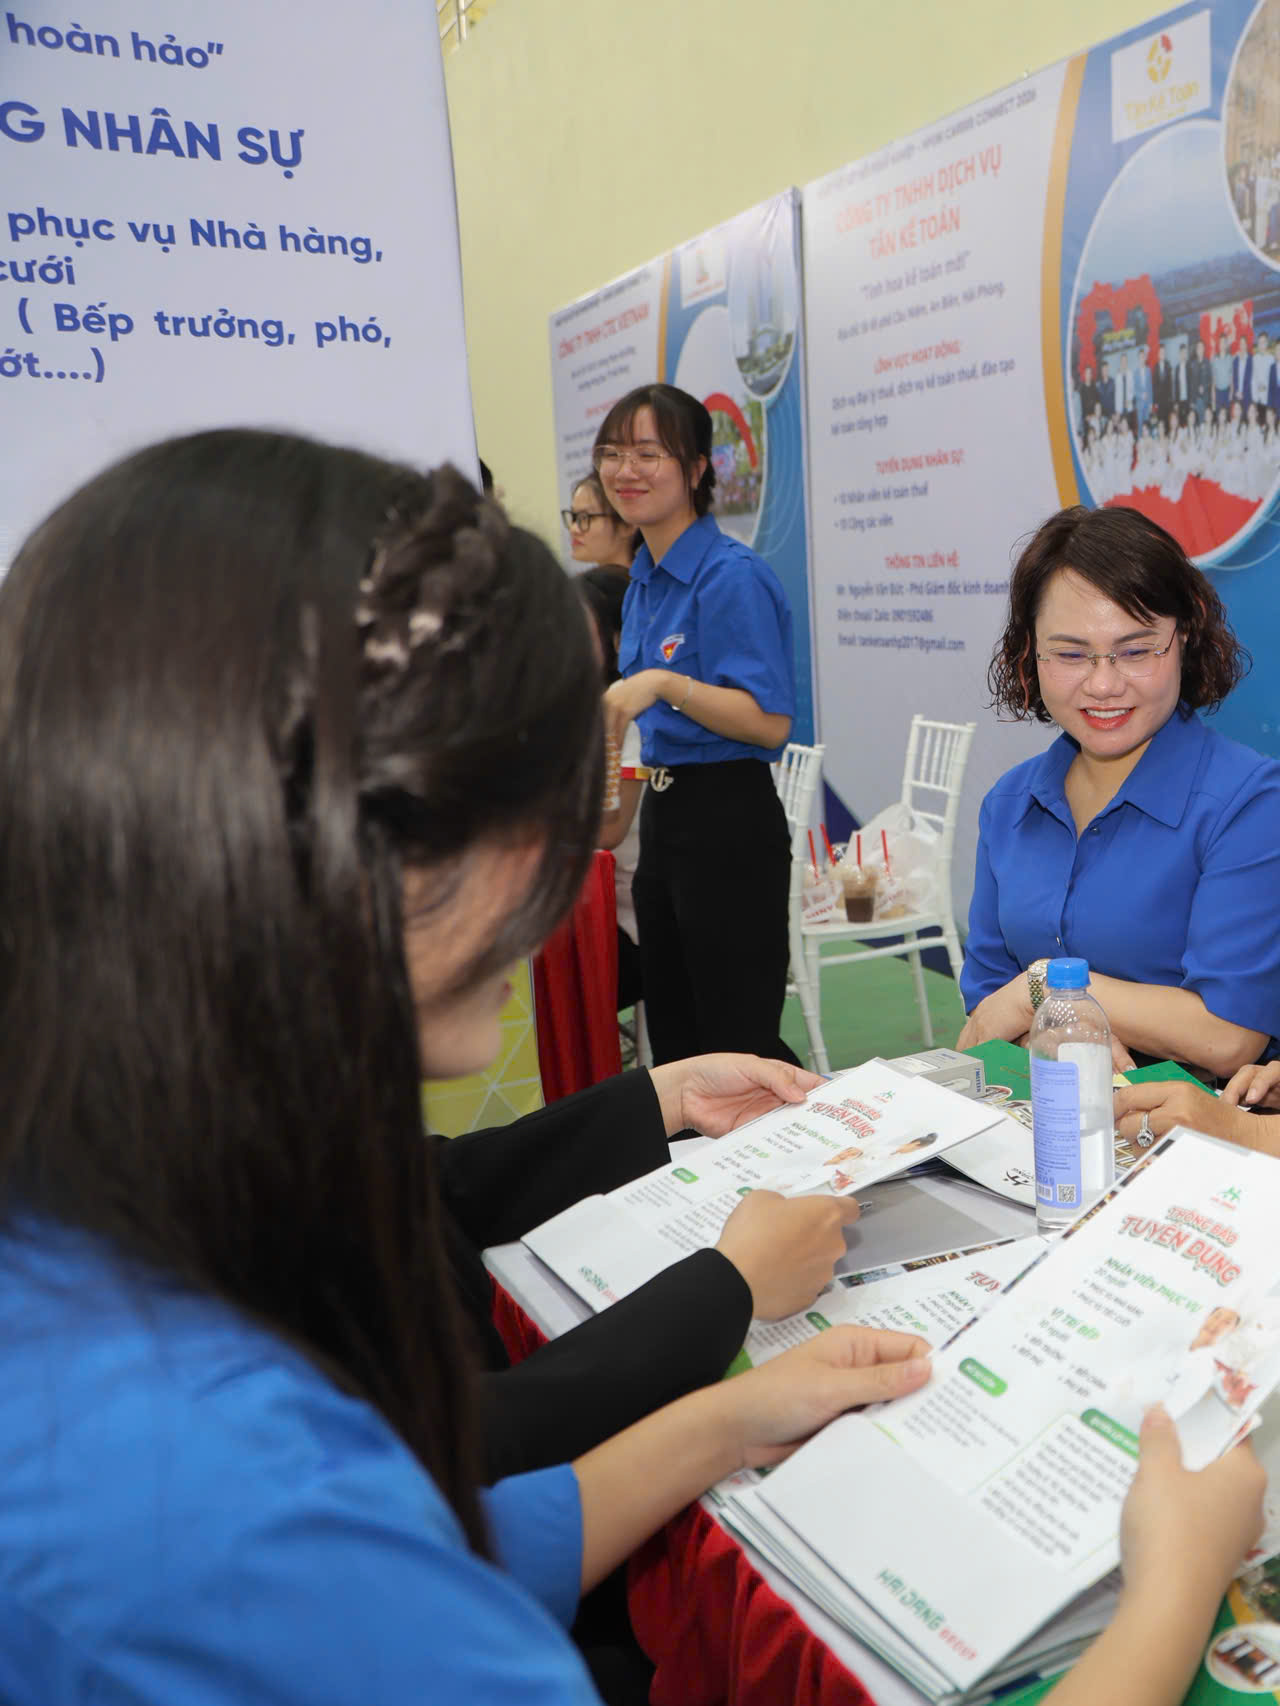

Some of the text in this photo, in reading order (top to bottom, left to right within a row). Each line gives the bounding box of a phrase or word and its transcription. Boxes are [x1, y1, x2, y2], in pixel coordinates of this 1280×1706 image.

[6, 13, 224, 69] hoàn hảo"
[62, 107, 222, 161] NHÂN
[237, 127, 305, 179] SỰ
[895, 172, 934, 210] TNHH
[8, 207, 383, 264] phục vụ Nhà hàng,
[54, 302, 134, 342] Bếp
[154, 308, 296, 347] trưởng,
[315, 315, 392, 348] phó,
